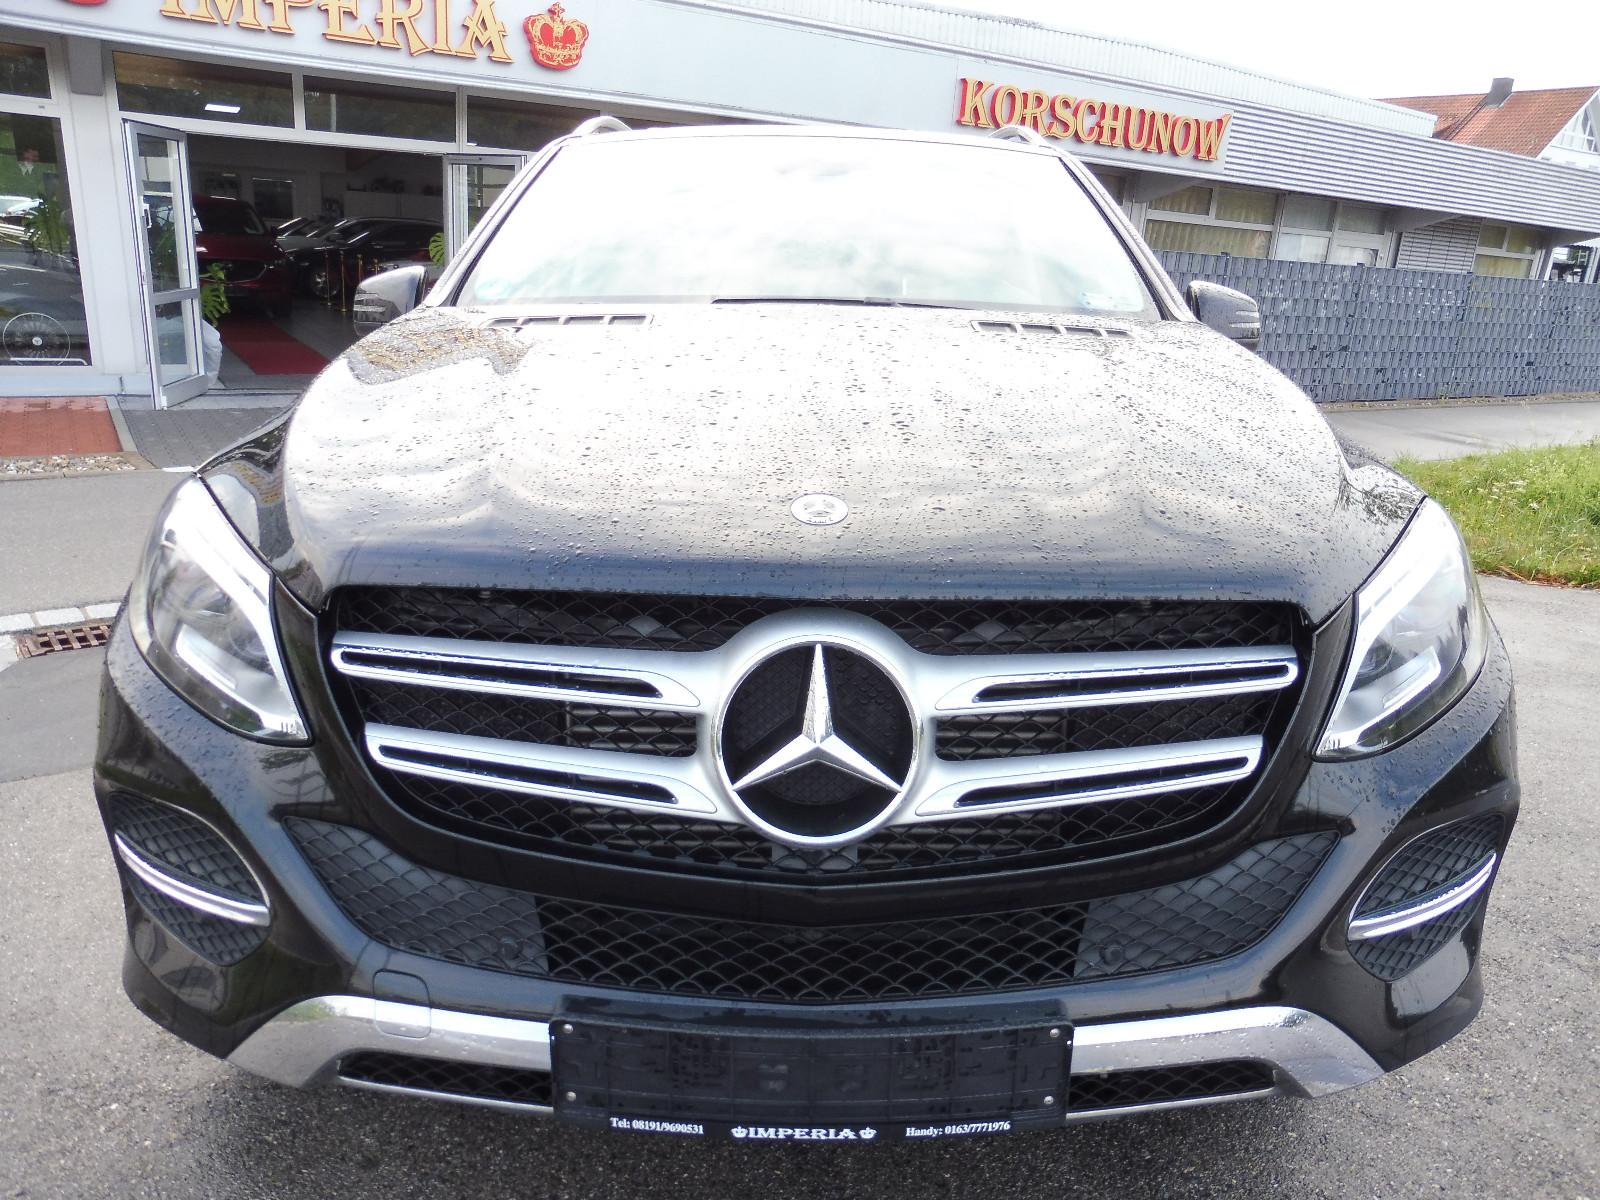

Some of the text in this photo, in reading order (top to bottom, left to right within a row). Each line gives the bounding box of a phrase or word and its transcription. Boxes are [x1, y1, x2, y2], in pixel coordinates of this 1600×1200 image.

[160, 0, 513, 63] PERIA
[956, 77, 1233, 161] KORSCHUNOW
[609, 1117, 704, 1134] Tel: 08191/9690531
[748, 1127, 858, 1139] IMPERIA
[905, 1121, 1011, 1137] Handy: 0163/7771976
